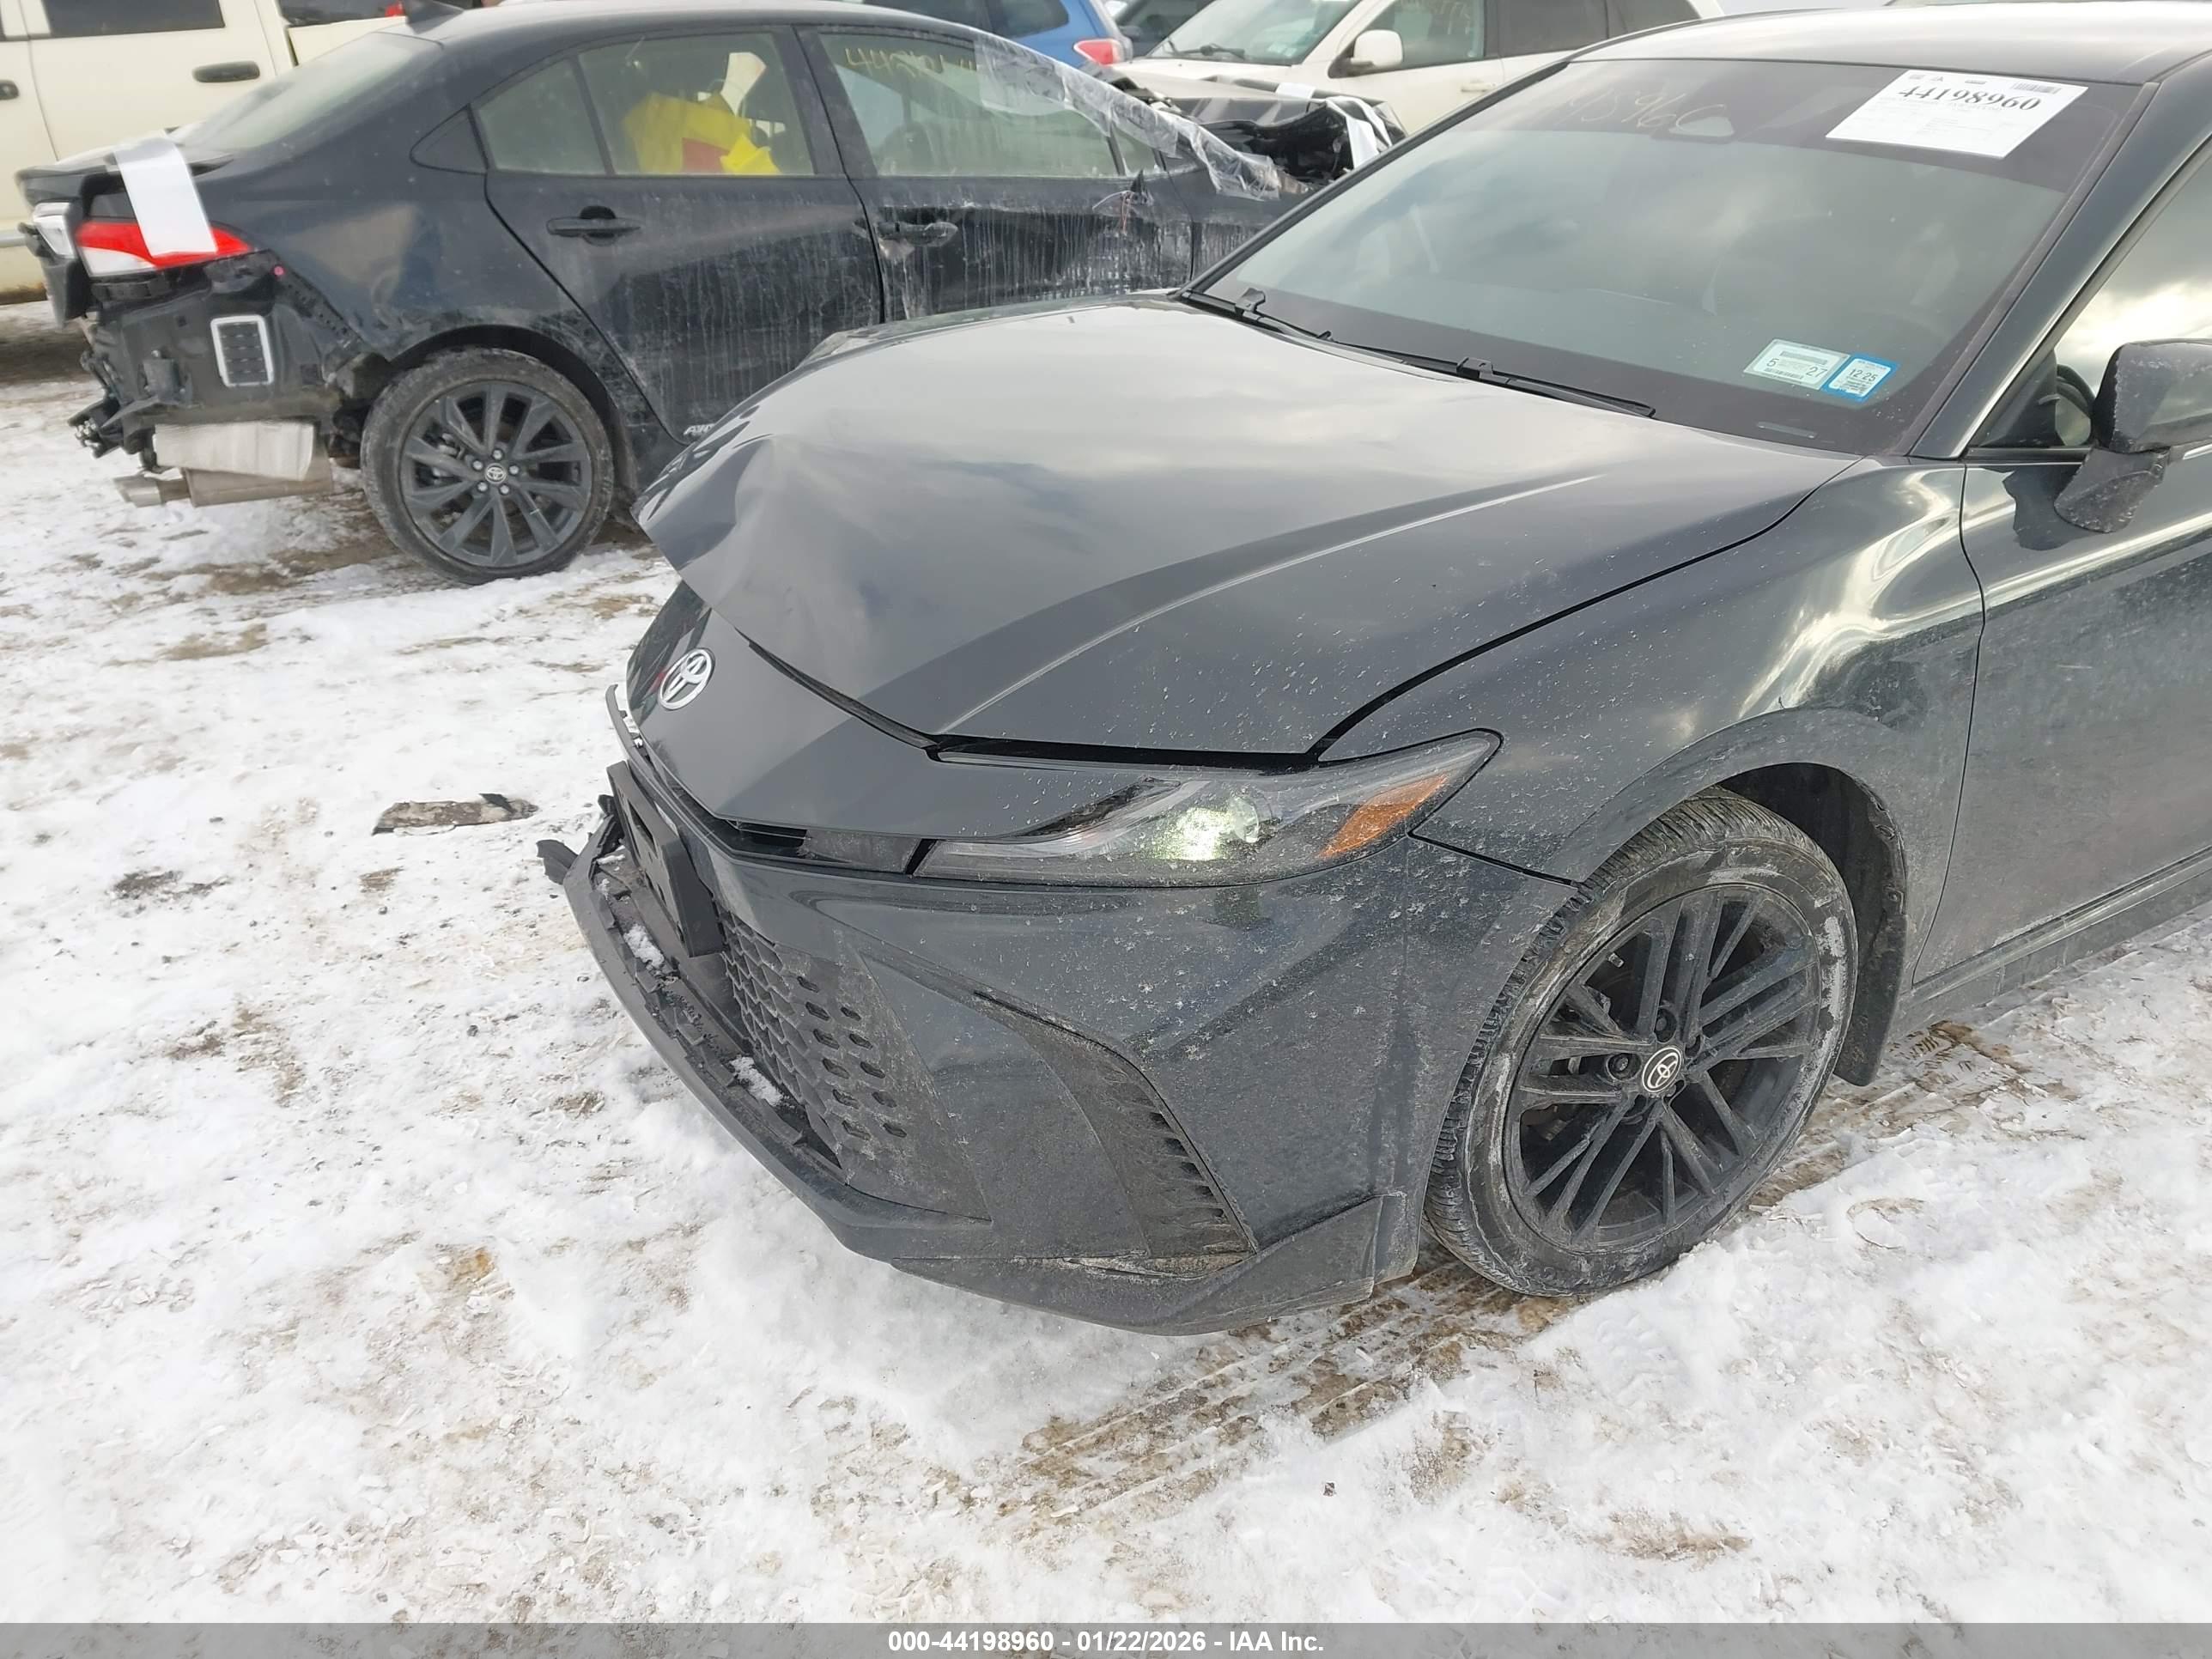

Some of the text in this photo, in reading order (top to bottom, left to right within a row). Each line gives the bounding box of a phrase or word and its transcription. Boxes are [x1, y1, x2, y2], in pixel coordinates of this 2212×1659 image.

[1897, 84, 2042, 112] 44198960
[1765, 357, 1779, 368] 5
[1807, 366, 1828, 378] 27
